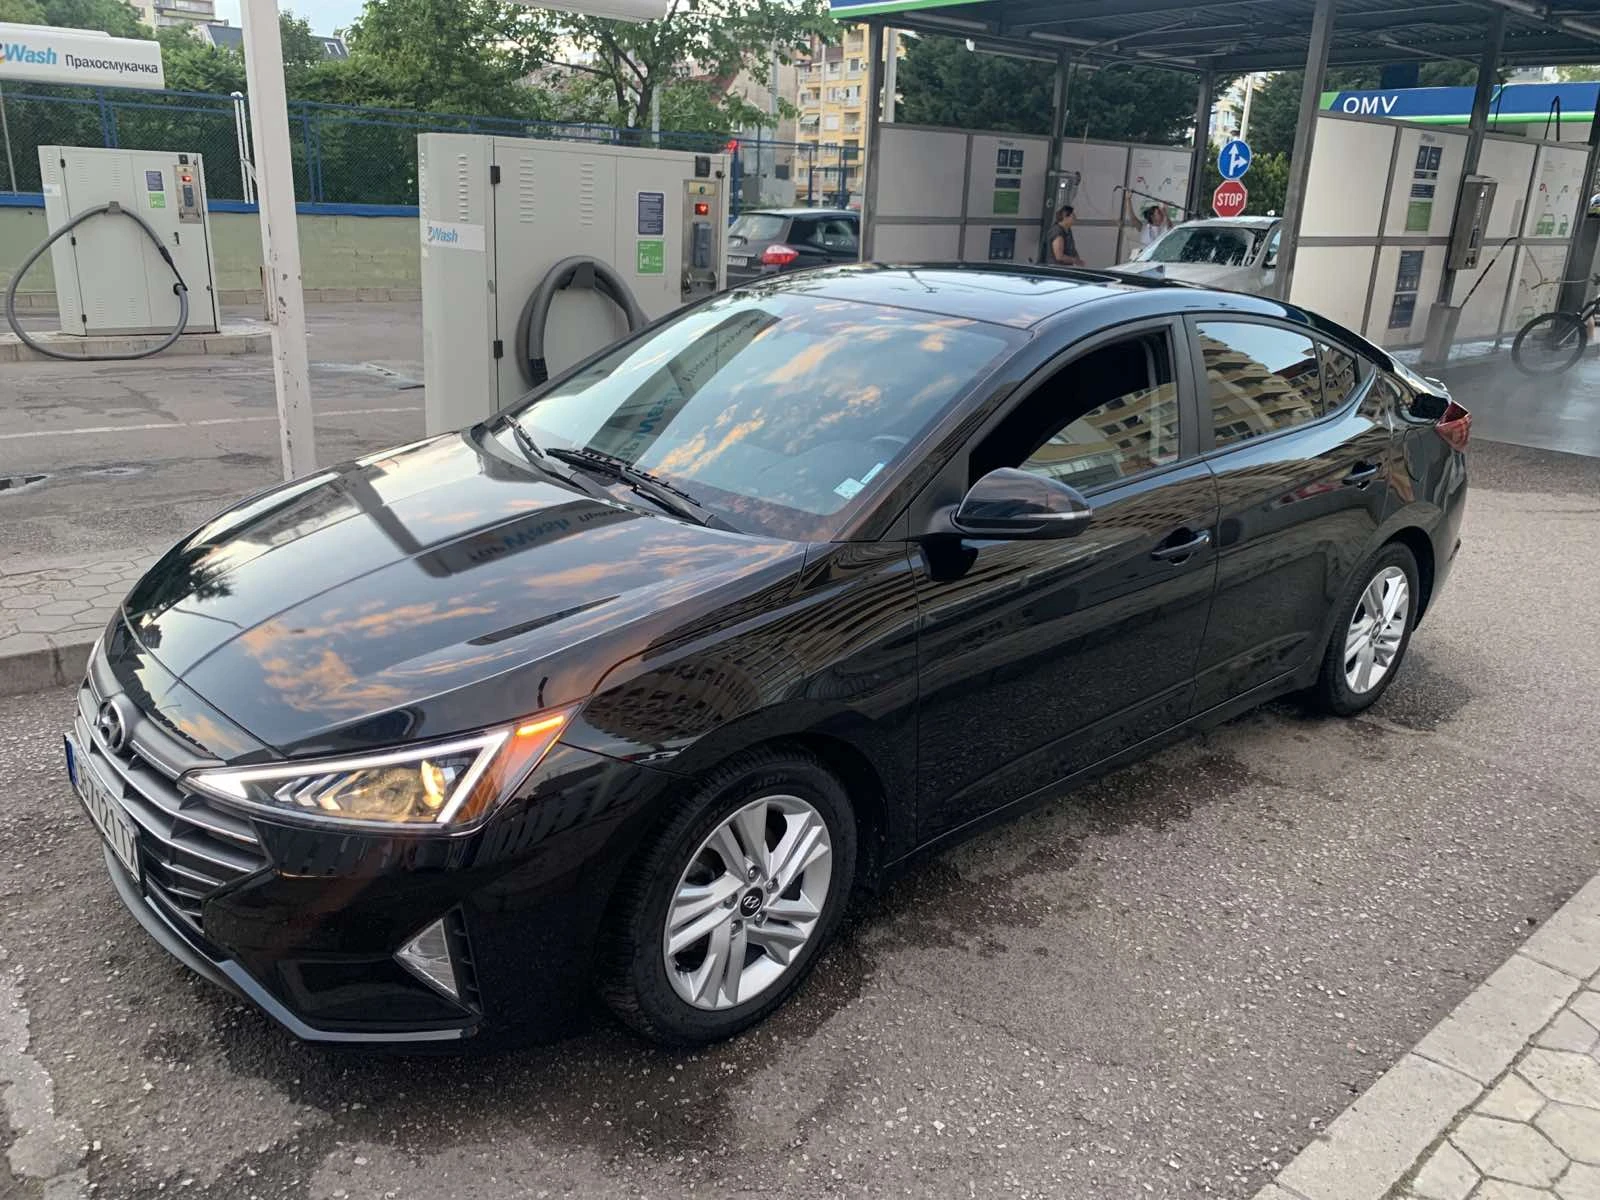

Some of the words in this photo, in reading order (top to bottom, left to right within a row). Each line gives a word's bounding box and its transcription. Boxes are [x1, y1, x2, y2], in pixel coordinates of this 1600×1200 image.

[0, 43, 57, 65] Wash
[65, 54, 158, 74] Прахосмукачка
[1343, 95, 1398, 114] OMV
[1216, 192, 1243, 207] STOP
